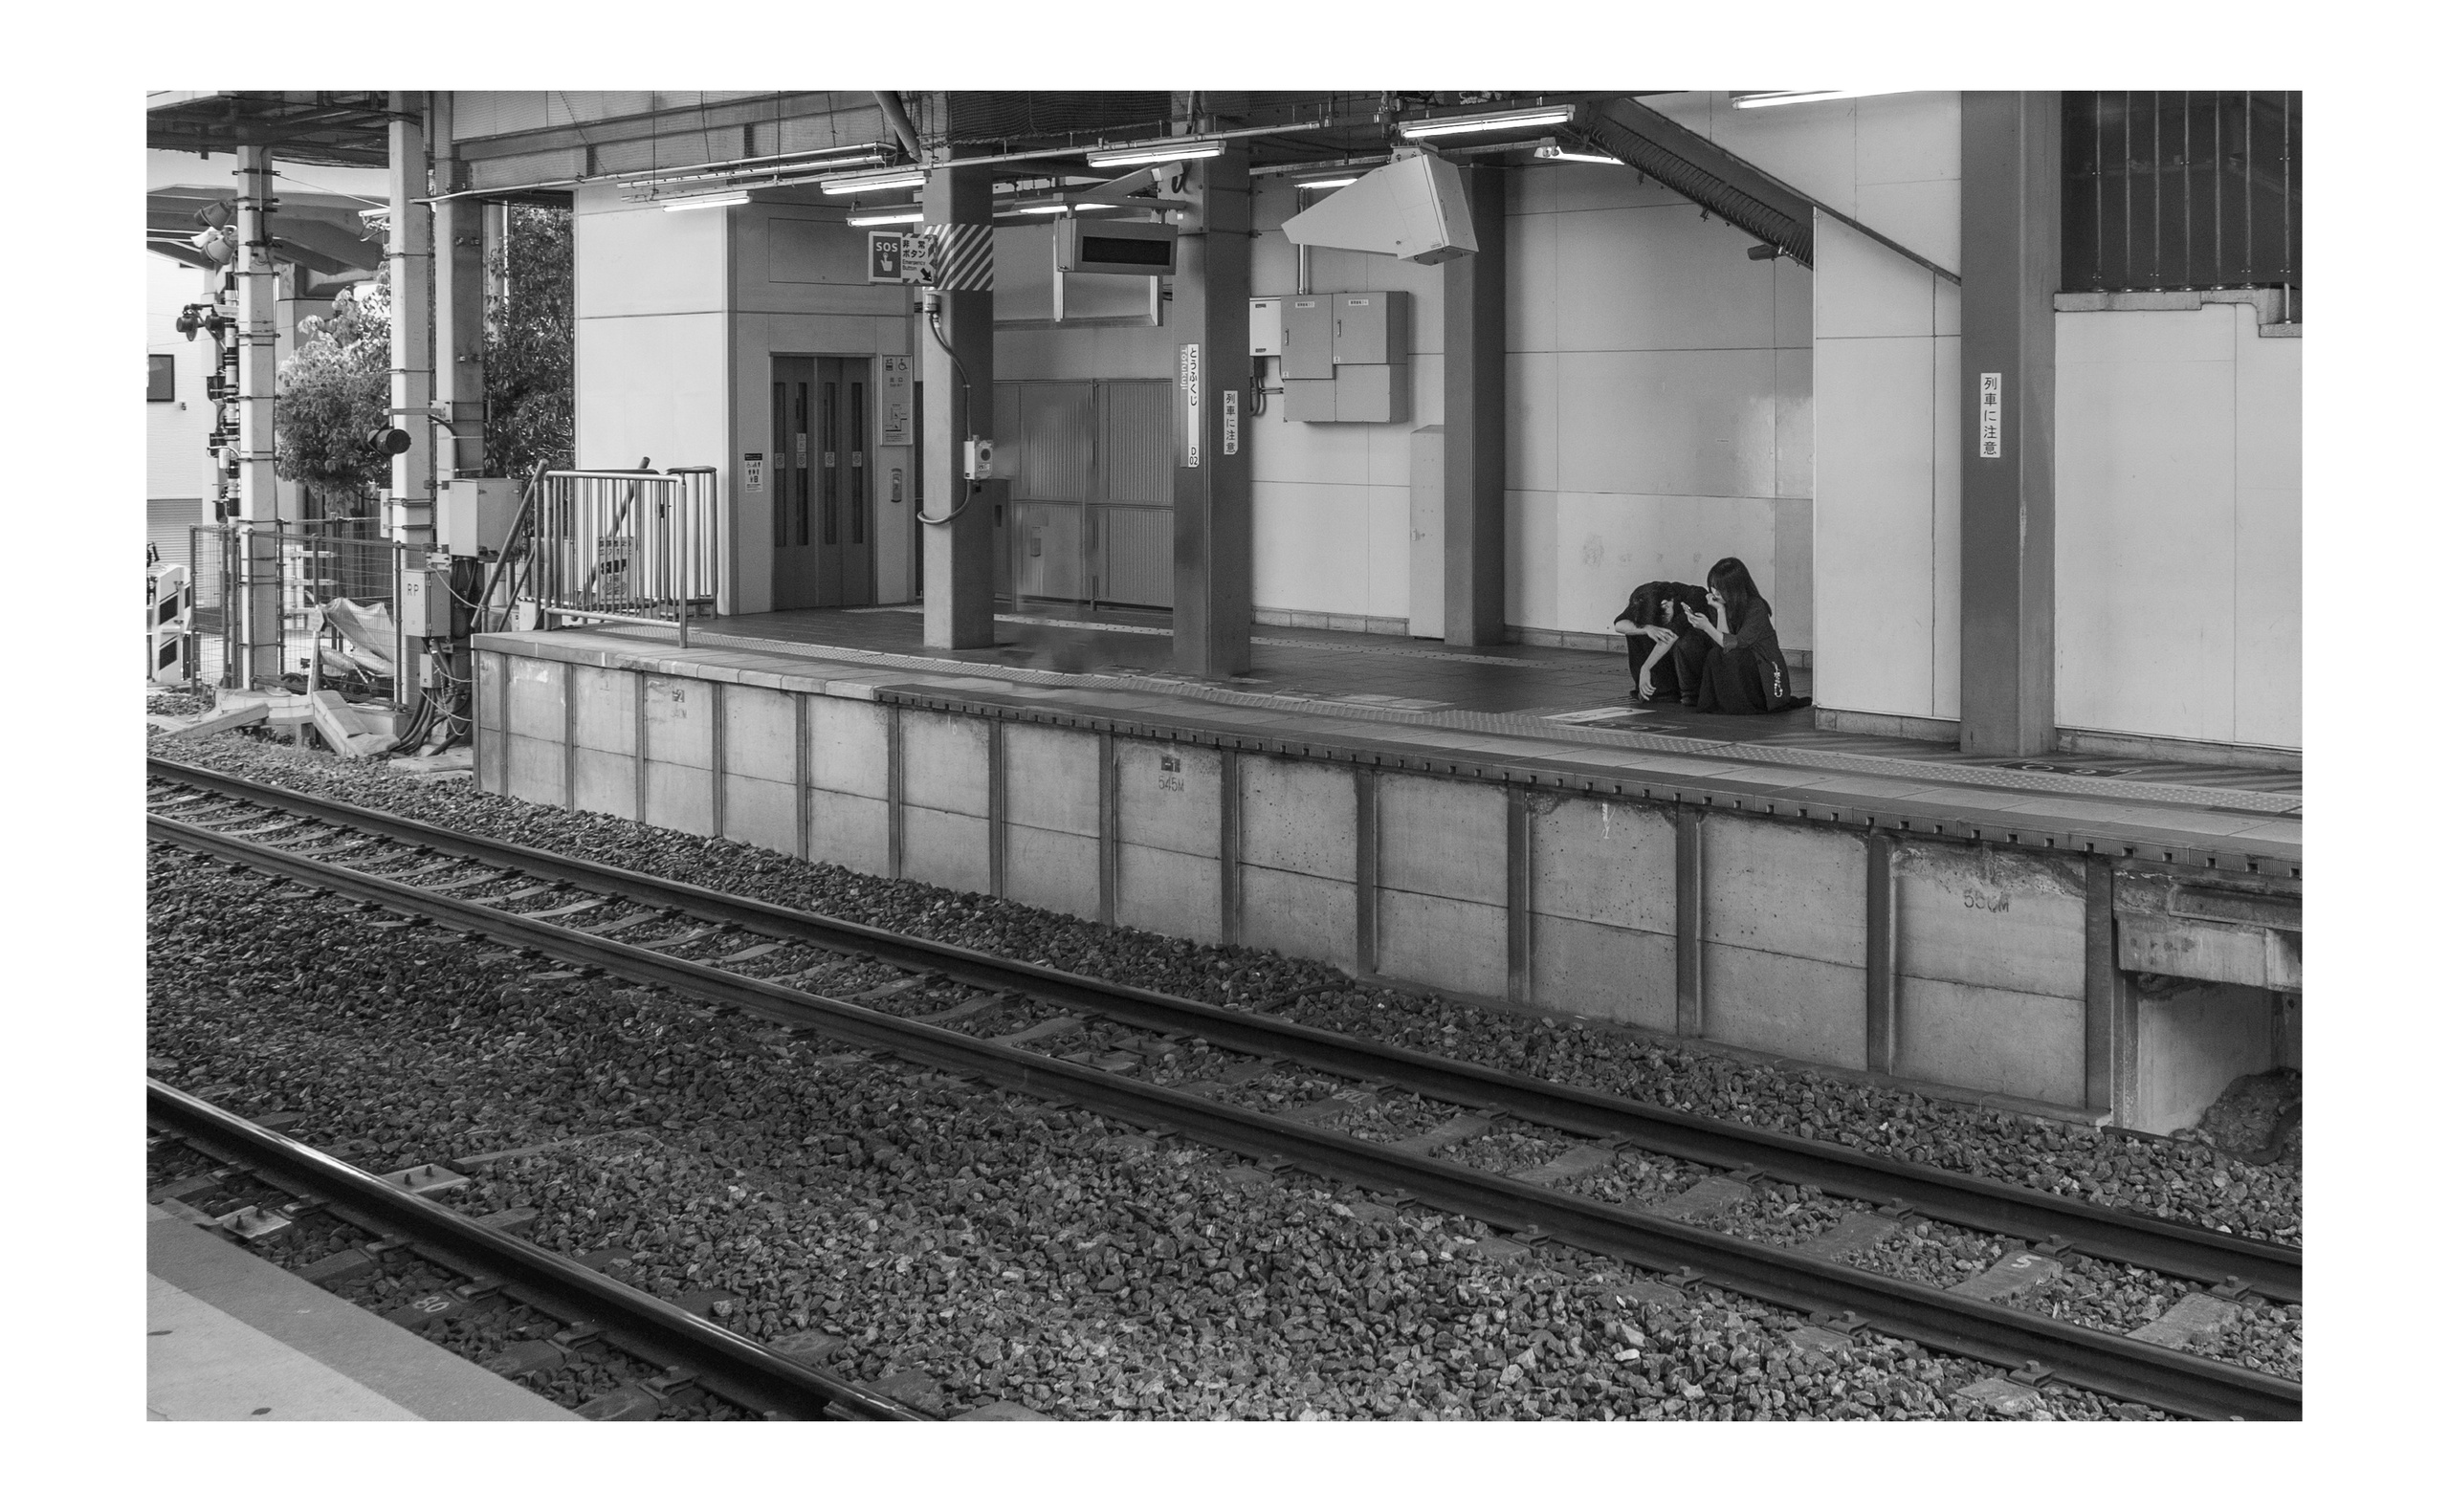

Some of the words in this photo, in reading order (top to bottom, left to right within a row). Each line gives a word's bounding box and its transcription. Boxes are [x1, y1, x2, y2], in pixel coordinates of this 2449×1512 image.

[876, 242, 898, 252] SOS
[903, 239, 926, 249] 非常
[903, 250, 926, 258] ボタン
[1189, 347, 1198, 406] とうふくじ
[1983, 377, 1997, 455] 列車に注意
[1225, 393, 1236, 453] 列車に注意
[1191, 447, 1197, 456] D
[1189, 456, 1199, 466] 02
[407, 583, 419, 596] RP
[1158, 776, 1184, 792] 545M
[413, 1296, 450, 1313] 80
